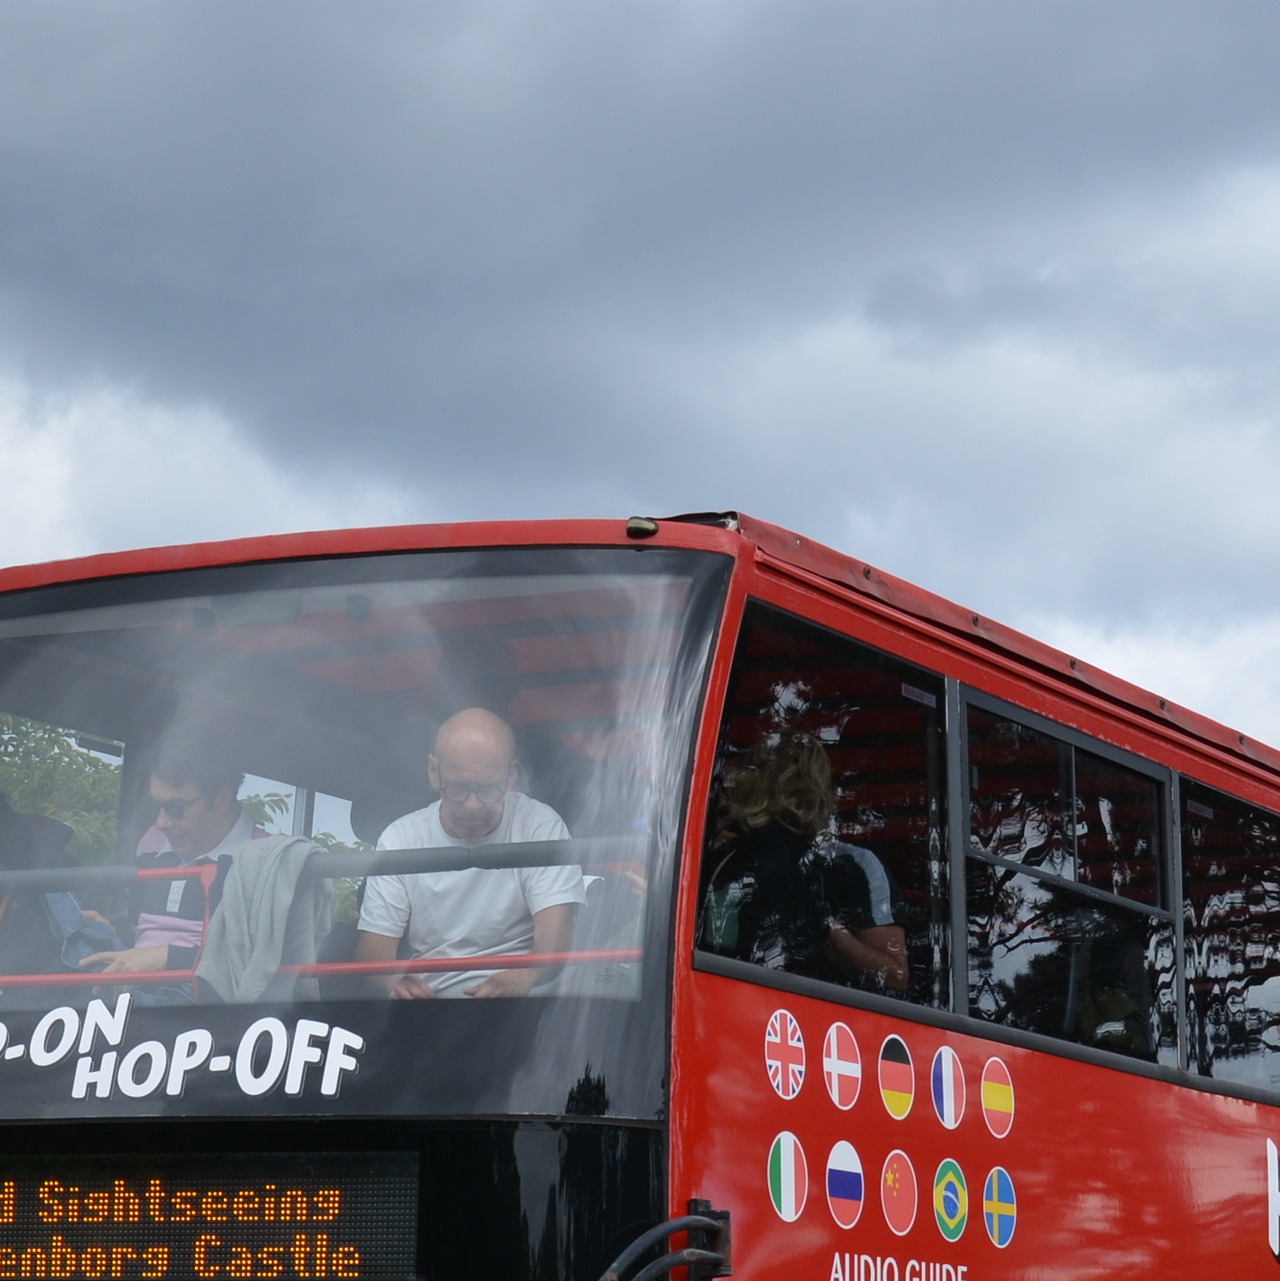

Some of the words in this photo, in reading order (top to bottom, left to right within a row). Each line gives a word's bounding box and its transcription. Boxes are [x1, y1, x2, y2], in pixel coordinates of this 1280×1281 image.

[71, 1016, 363, 1098] HOP-OFF
[38, 1179, 341, 1223] Sightseeing
[193, 1234, 361, 1277] Castle
